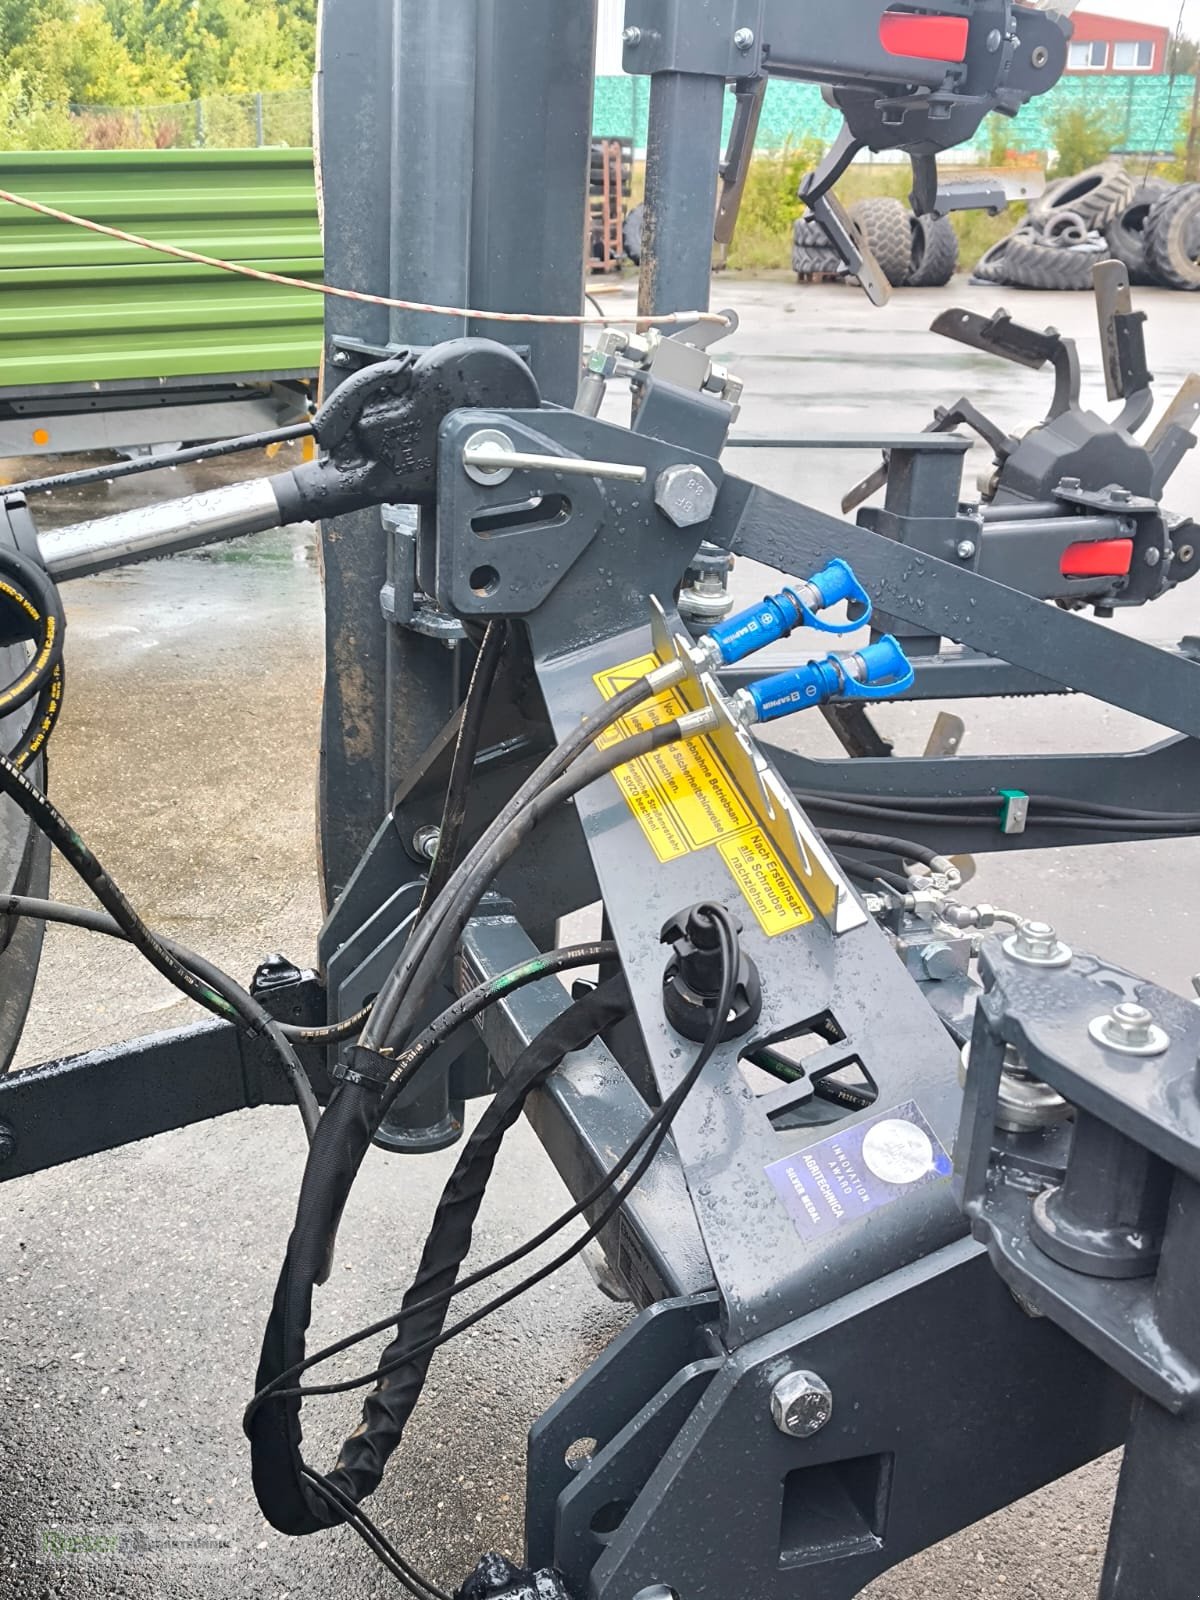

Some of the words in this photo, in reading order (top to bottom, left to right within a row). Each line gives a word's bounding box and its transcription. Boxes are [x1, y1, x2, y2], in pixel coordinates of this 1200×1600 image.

[631, 715, 645, 732] lese
[653, 753, 679, 793] beachten.
[647, 709, 662, 725] leitu
[666, 742, 679, 752] nd
[673, 752, 725, 833] Sicherheitshinweise
[663, 703, 676, 717] Vor
[684, 738, 712, 777] iebnahme
[708, 778, 741, 825] Betriebsan-
[627, 762, 651, 798] ffentlichen
[646, 798, 680, 852] Straßenverkehr
[634, 796, 659, 832] beachten!
[730, 856, 770, 915] nachziehen!
[740, 843, 756, 863] alle
[751, 863, 786, 917] Schrauben
[750, 834, 771, 861] Nach
[765, 861, 803, 917] Ersteinsatz
[785, 1167, 806, 1197] SILVER
[801, 1194, 821, 1223] MEDAL
[803, 1153, 845, 1218] AGRITECHNICA
[828, 1160, 853, 1195] AWARD
[832, 1144, 871, 1202] INNOVATION
